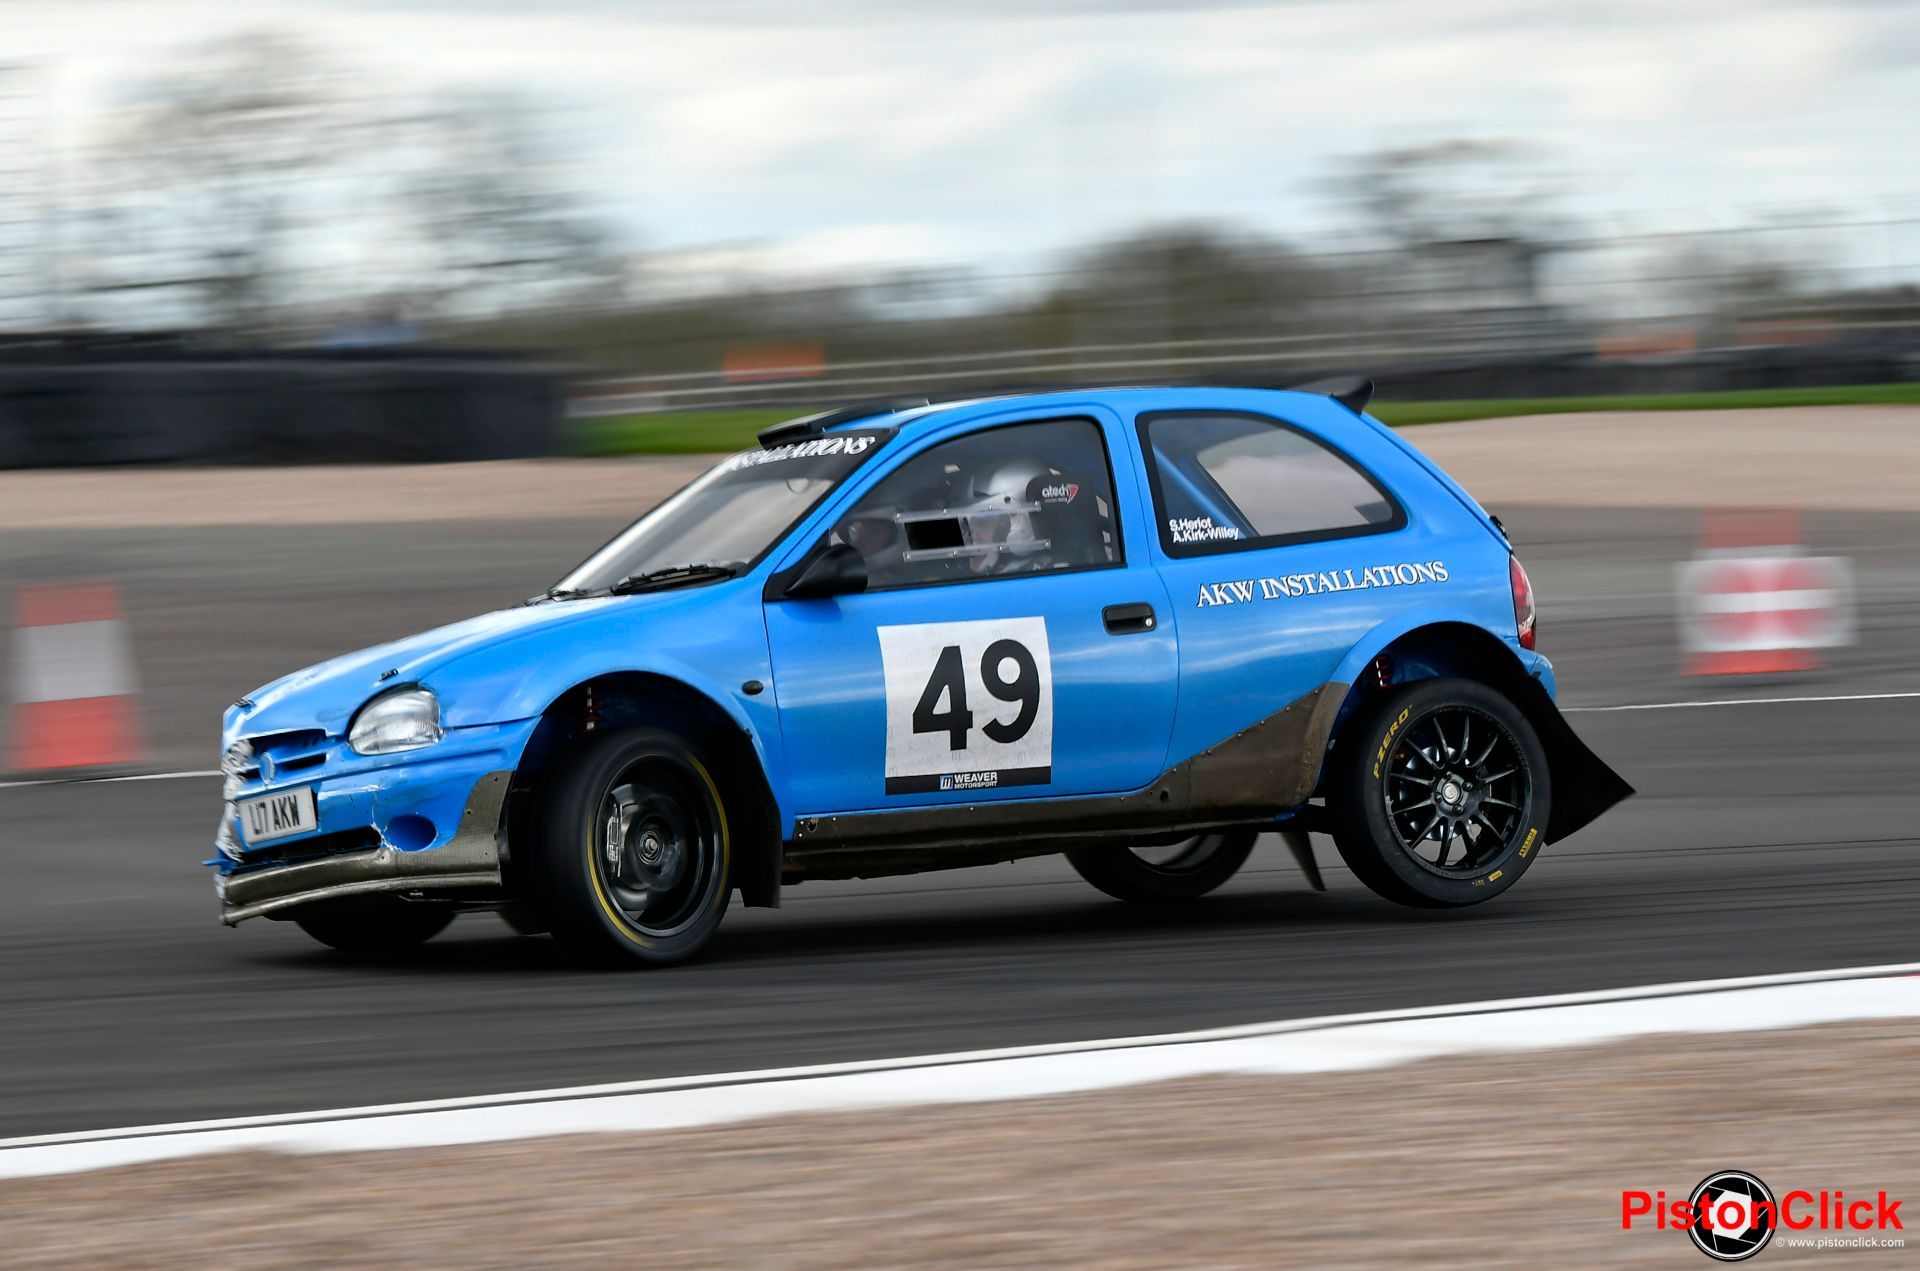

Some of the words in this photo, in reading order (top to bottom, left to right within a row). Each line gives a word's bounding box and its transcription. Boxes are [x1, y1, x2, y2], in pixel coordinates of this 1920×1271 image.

[1173, 526, 1239, 543] A.Kirk-Willey
[1197, 580, 1255, 608] AKW
[1258, 560, 1450, 600] INSTALLATIONS
[912, 638, 1041, 751] 49
[954, 771, 998, 783] WEAVER
[954, 780, 998, 789] MOTORSPORT
[272, 794, 301, 831] AKW
